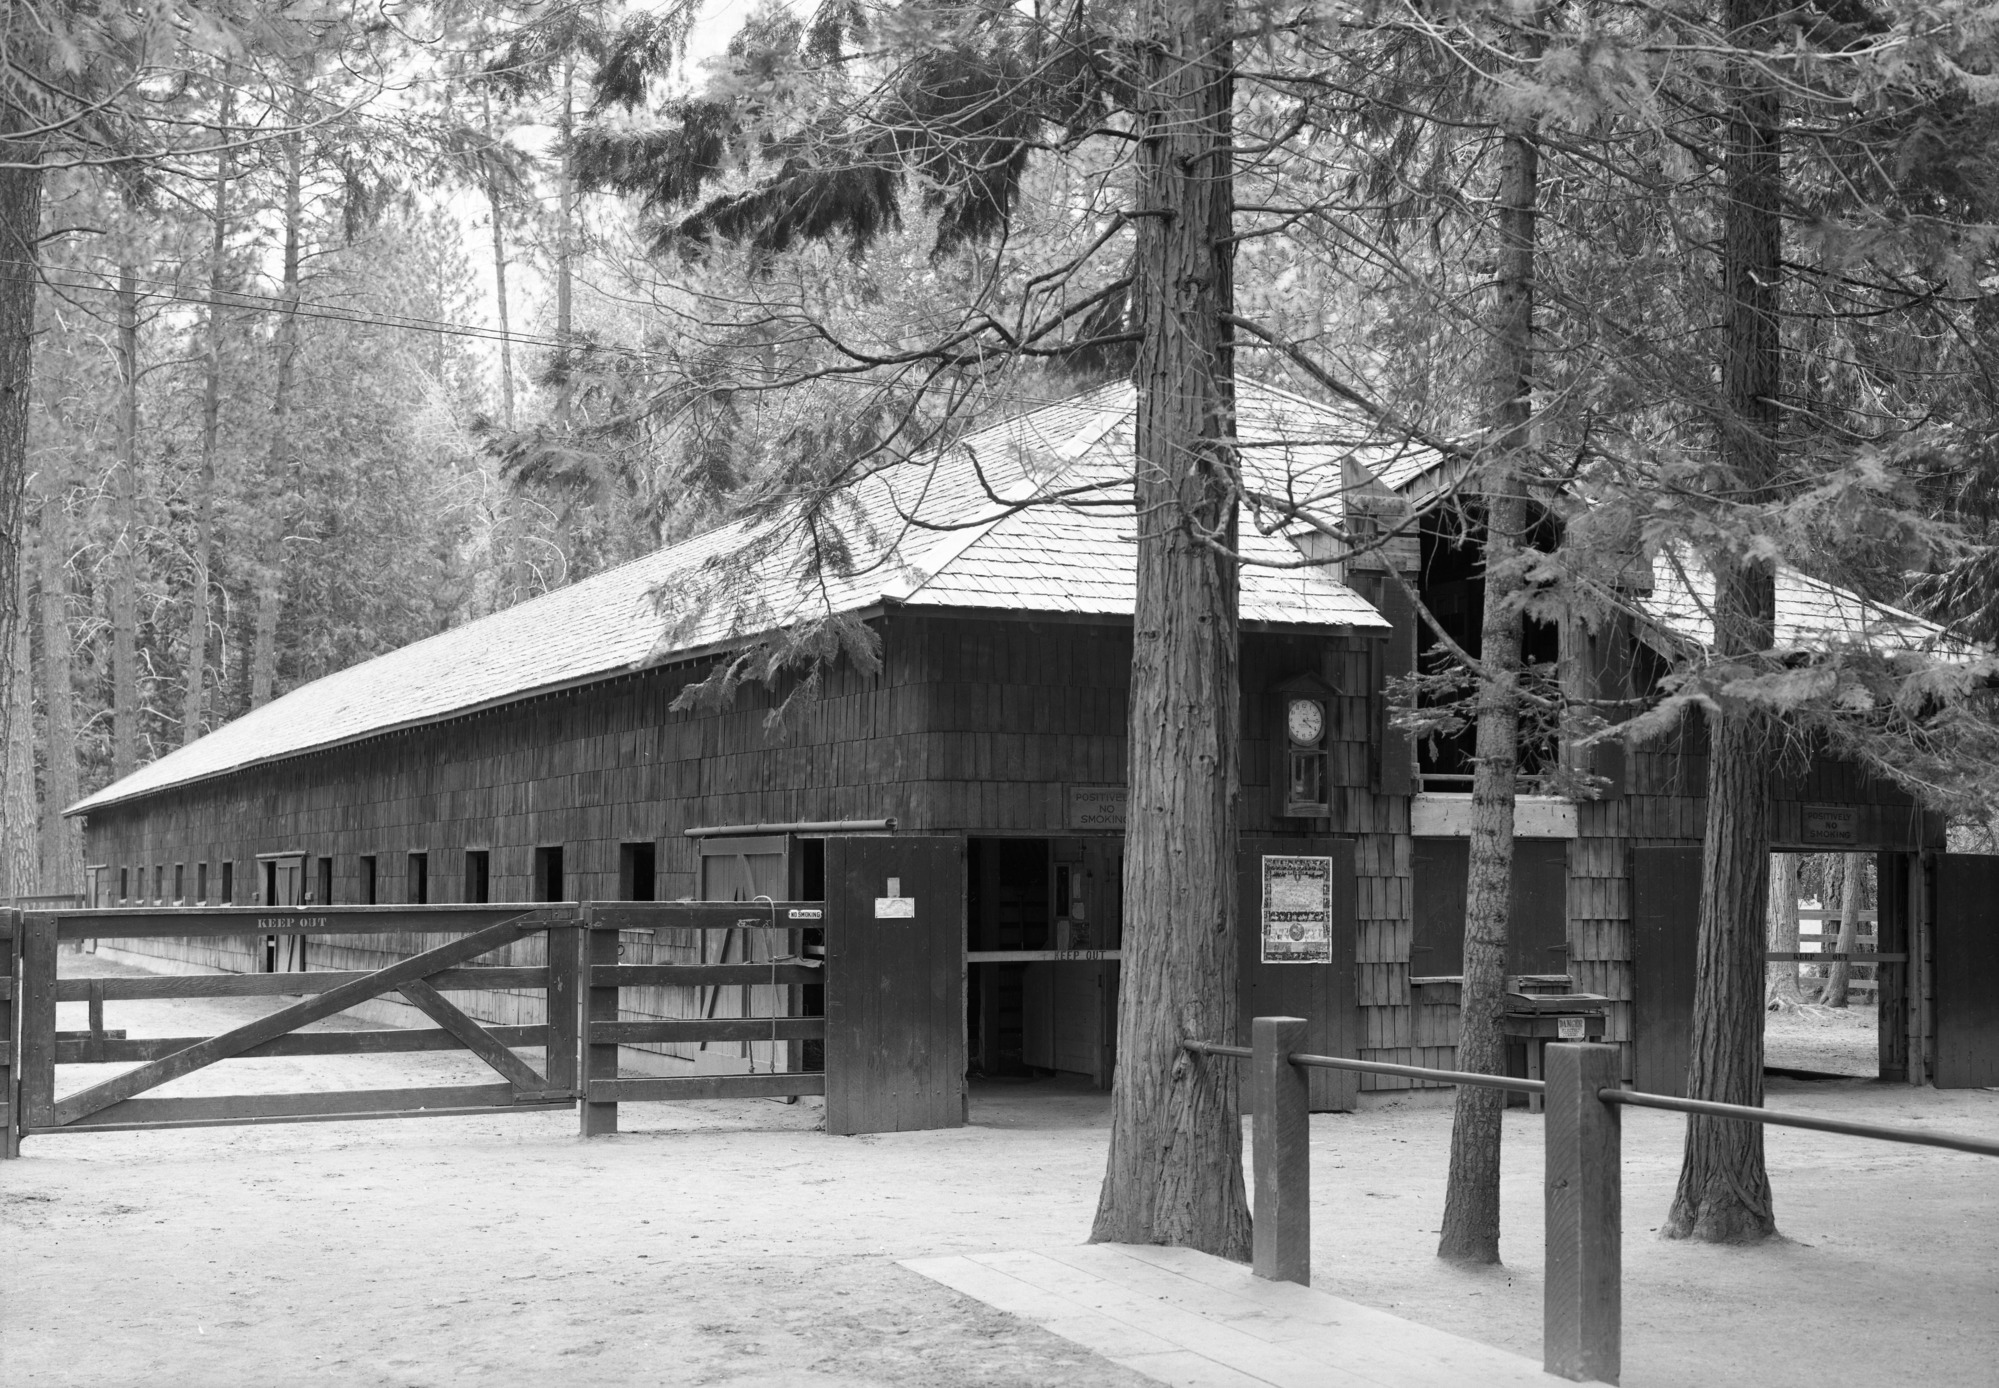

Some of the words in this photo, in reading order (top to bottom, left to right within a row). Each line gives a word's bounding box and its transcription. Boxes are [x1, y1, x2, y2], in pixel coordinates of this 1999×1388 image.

[1075, 792, 1128, 801] POSITIVEL
[1099, 804, 1115, 814] NO
[1807, 811, 1853, 821] POSITIVELY
[1825, 821, 1838, 830] NO
[1809, 830, 1851, 839] SMOKING
[257, 918, 295, 929] KEEP
[299, 917, 327, 928] OUT
[1054, 950, 1080, 960] KEEP
[1086, 950, 1107, 960] OUT
[1793, 953, 1815, 961] KEEP
[1832, 953, 1849, 961] OUT
